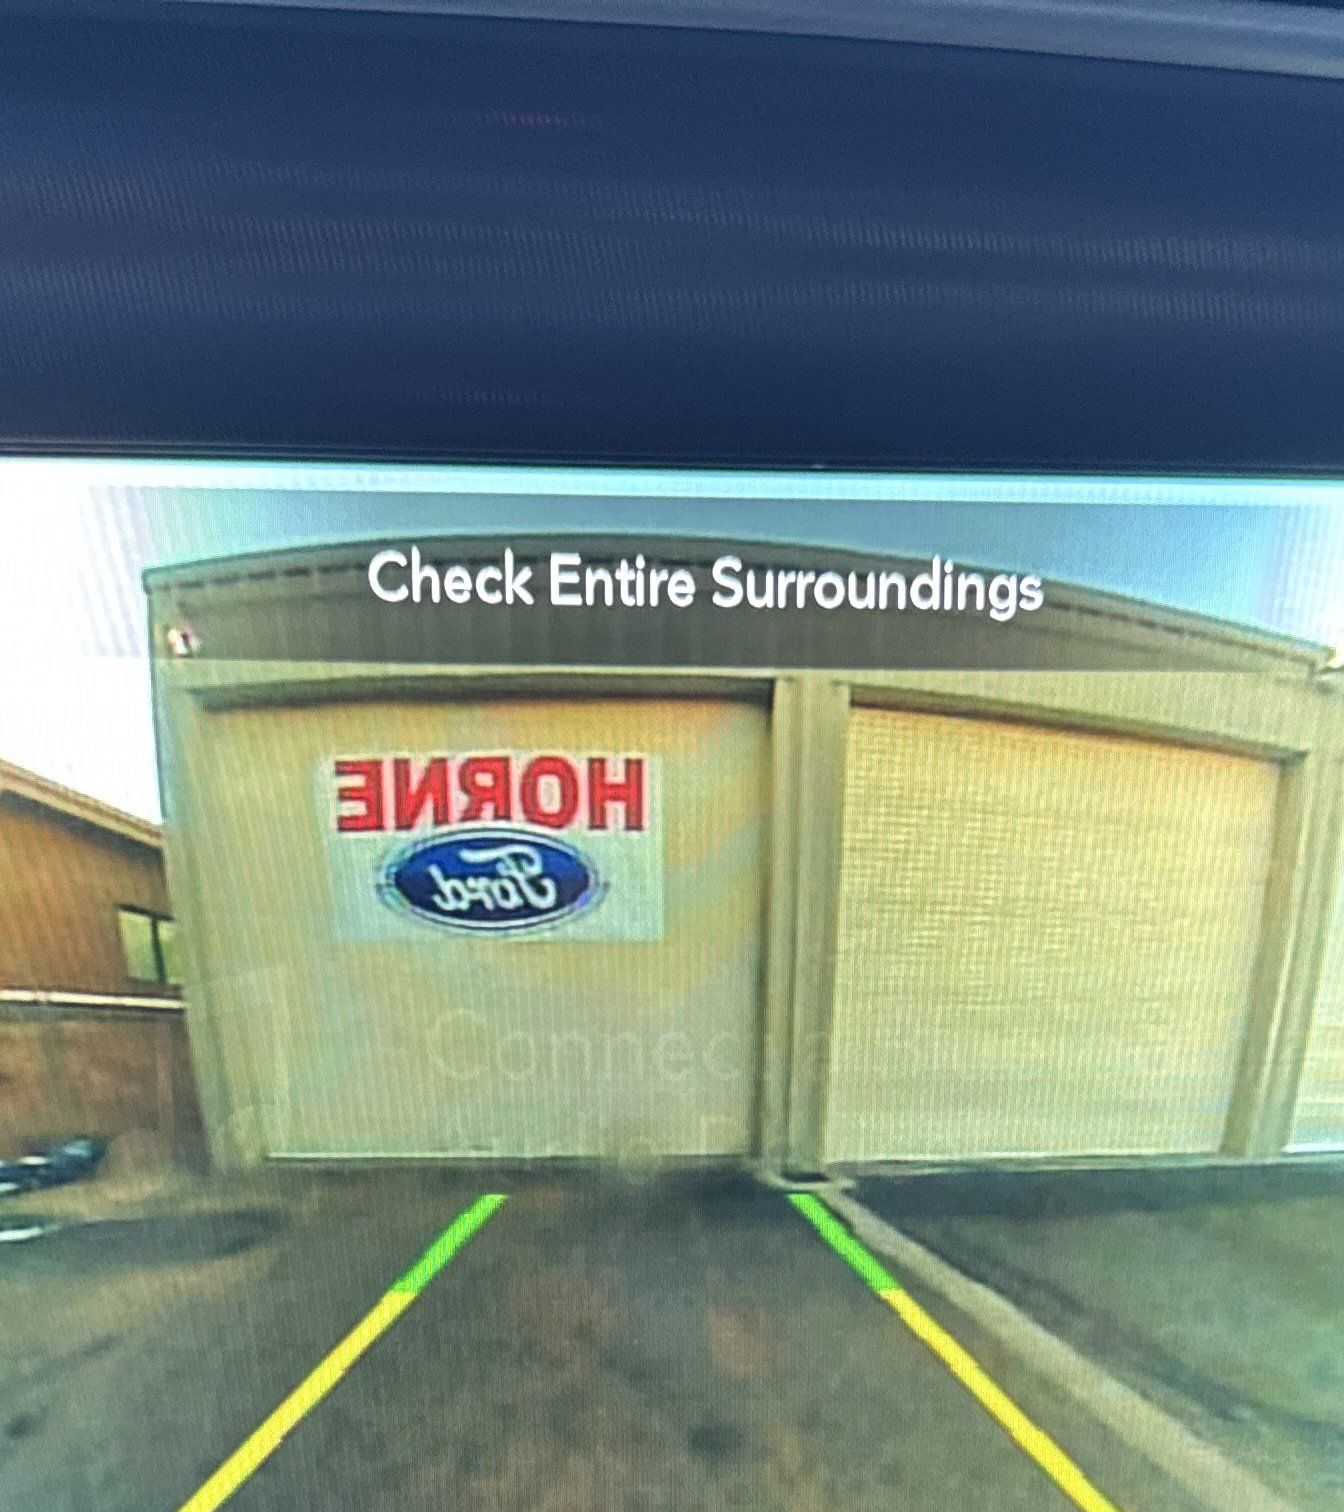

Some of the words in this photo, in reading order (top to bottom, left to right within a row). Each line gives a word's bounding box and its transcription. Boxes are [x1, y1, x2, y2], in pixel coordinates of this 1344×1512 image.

[367, 546, 535, 605] Check
[549, 551, 696, 607] Entire
[711, 554, 1044, 622] Surroundings
